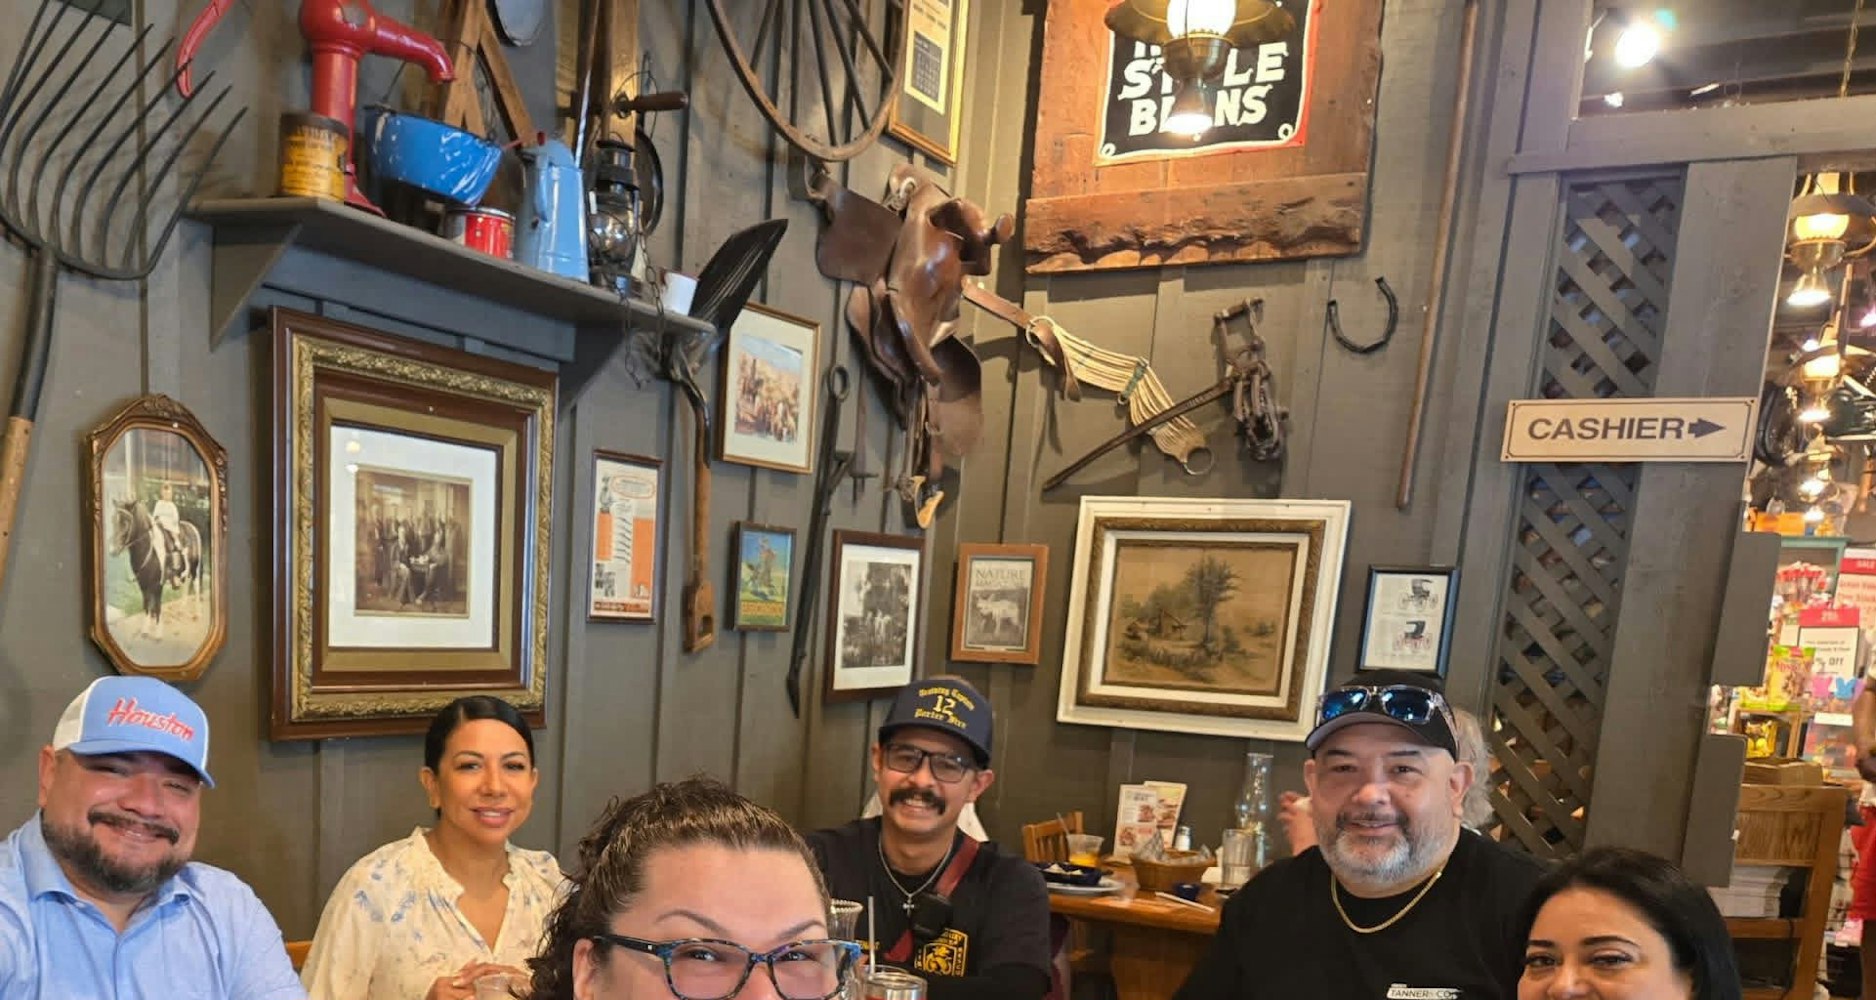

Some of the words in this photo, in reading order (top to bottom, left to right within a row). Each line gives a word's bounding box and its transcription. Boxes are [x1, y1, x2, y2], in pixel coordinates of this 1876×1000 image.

[1117, 42, 1289, 100] STLE
[1129, 84, 1273, 136] BNS
[1528, 417, 1684, 440] CASHIER
[107, 697, 195, 741] Houston
[932, 695, 957, 716] 12
